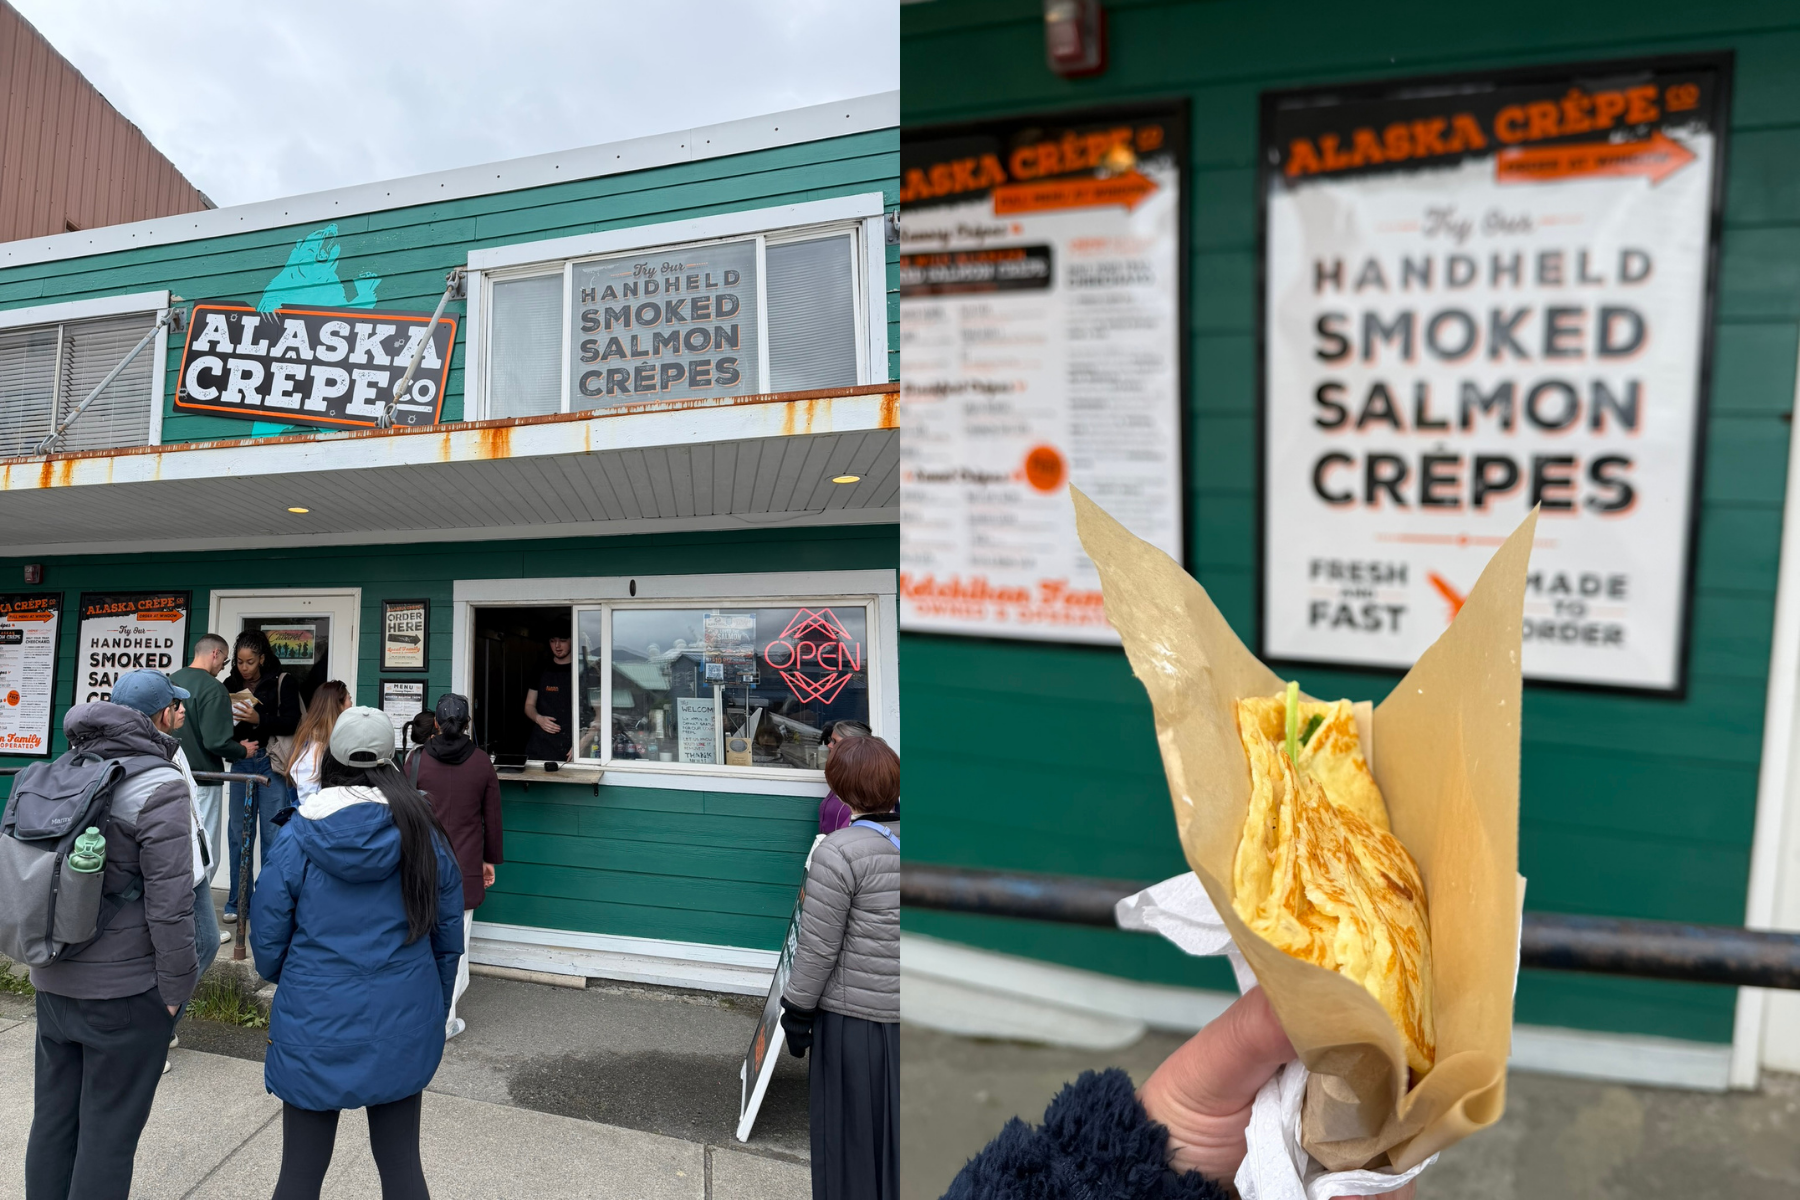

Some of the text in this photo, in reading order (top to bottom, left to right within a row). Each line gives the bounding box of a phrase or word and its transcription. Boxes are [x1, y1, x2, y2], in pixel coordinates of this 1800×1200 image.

[1285, 113, 1488, 178] ALASKA
[1493, 88, 1660, 144] CRÊPE
[1422, 207, 1475, 245] Try
[633, 261, 686, 278] Try Our
[1313, 247, 1654, 296] HANDHELD
[580, 270, 741, 304] HANDHELD
[580, 294, 741, 334] SMOKED
[192, 313, 443, 370] ALASKA
[579, 324, 741, 364] SALMON
[1315, 304, 1650, 367] SMOKED
[185, 349, 437, 417] CRÊPE CO
[578, 356, 742, 398] CRÊPES
[1313, 378, 1645, 437] SALMON
[1310, 442, 1642, 517] CRÊPES
[1309, 558, 1409, 586] FRESH
[1526, 570, 1629, 601] MADE
[86, 601, 136, 615] ALASKA
[387, 612, 422, 621] ORDER
[1309, 601, 1407, 634] FAST
[1554, 600, 1587, 619] TO
[119, 625, 146, 636] Try Our
[387, 621, 423, 632] HERE
[1522, 618, 1625, 649] ORDER
[91, 638, 174, 648] HANDHELD
[764, 640, 860, 671] OPEN
[89, 652, 172, 669] SMOKED
[7, 732, 42, 748] Family
